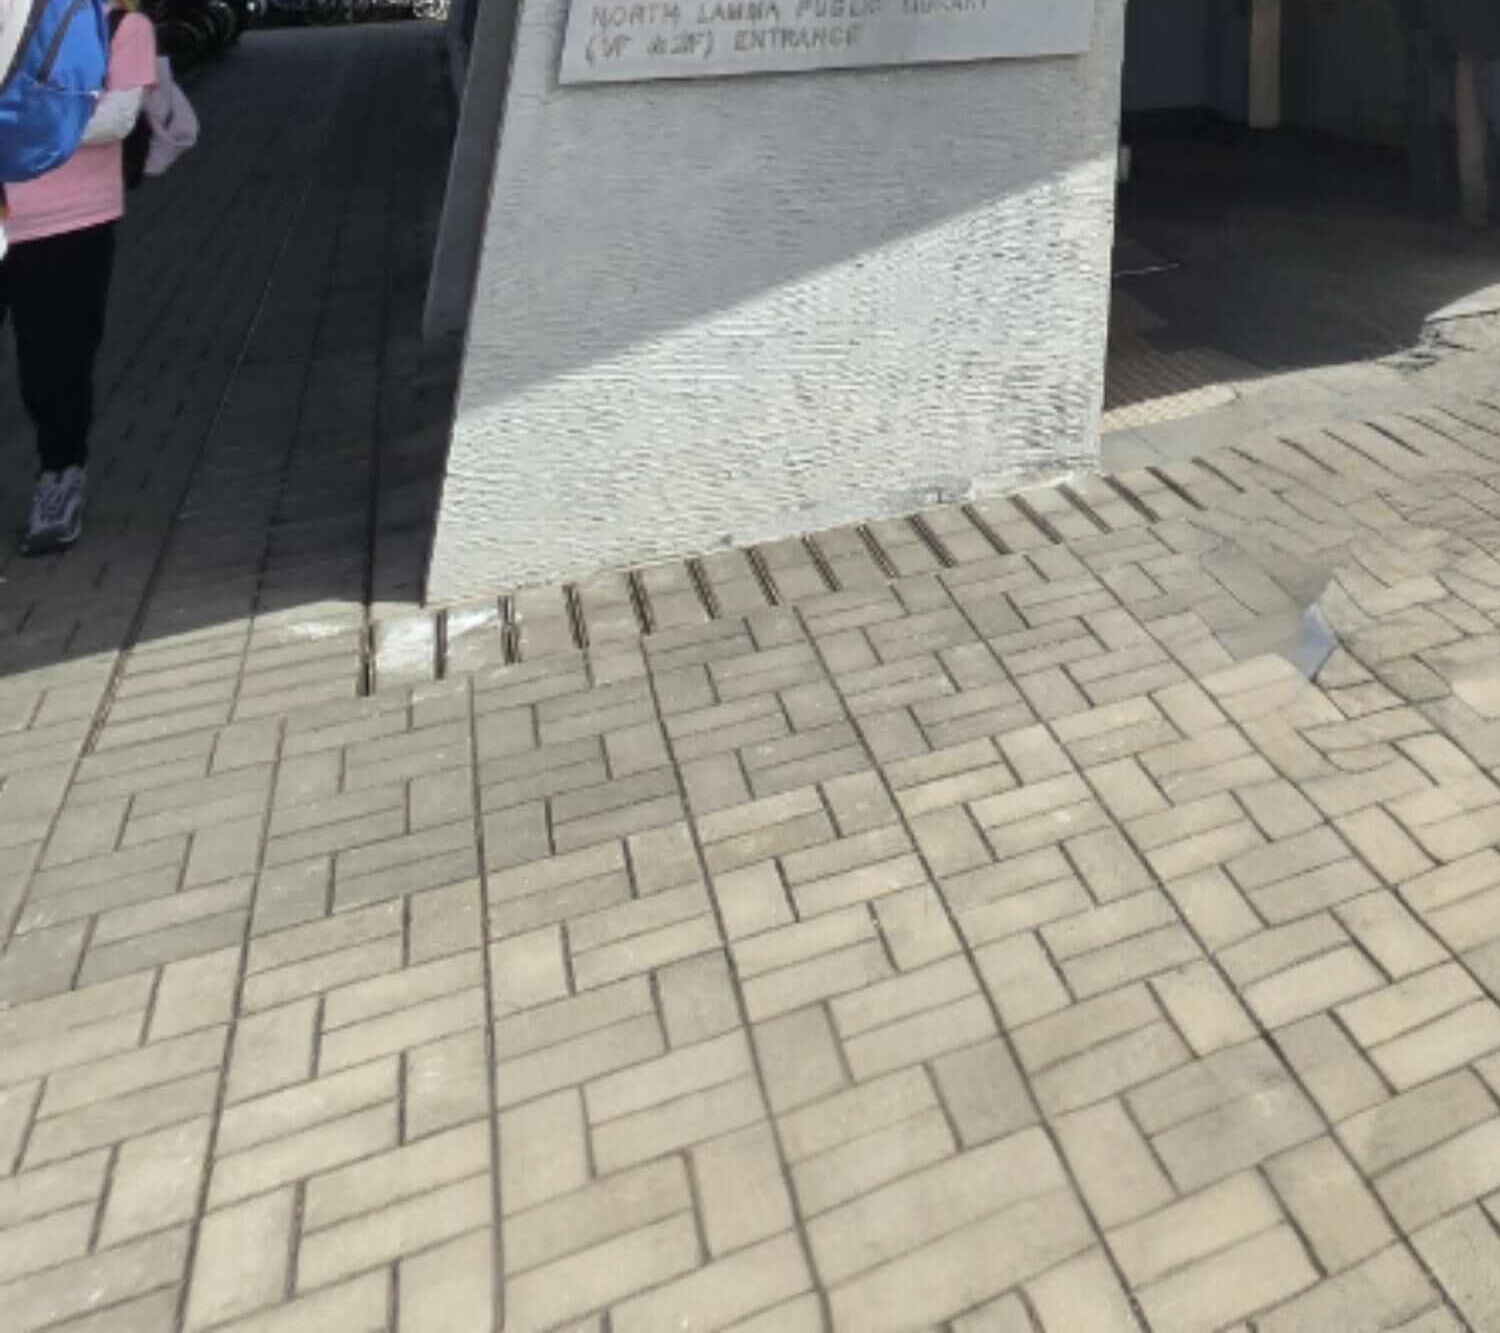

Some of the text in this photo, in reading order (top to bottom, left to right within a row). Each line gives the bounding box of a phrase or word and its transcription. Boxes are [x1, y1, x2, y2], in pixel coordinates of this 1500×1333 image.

[591, 2, 681, 30] NORTH
[697, 0, 781, 25] LAMMA
[734, 22, 862, 52] ENTRANCE
